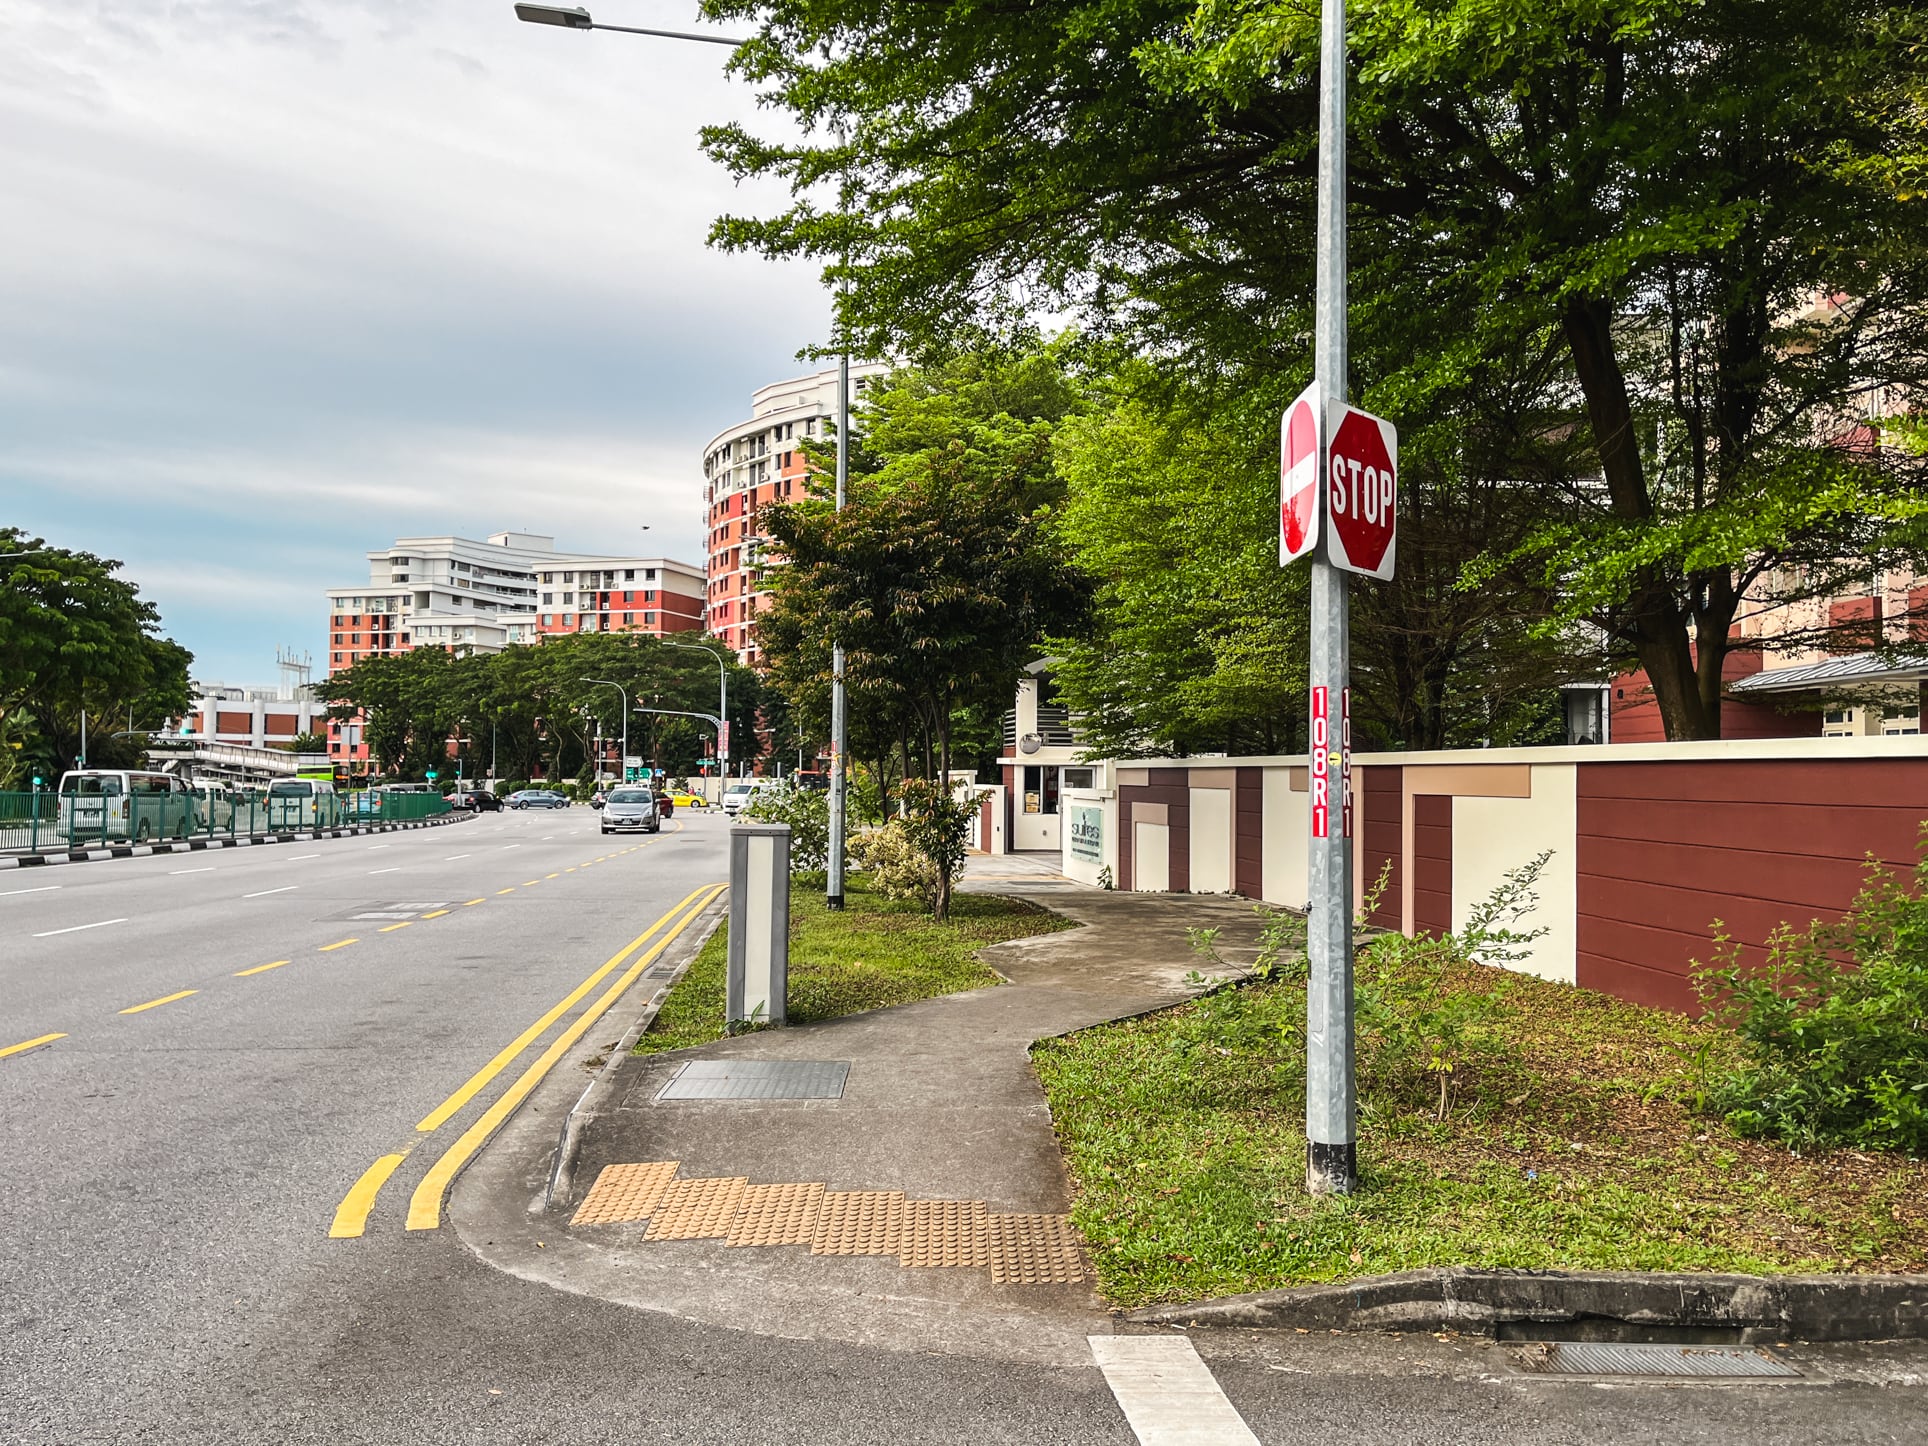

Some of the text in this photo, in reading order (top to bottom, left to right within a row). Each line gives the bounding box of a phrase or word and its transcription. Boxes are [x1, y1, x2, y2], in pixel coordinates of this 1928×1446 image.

[1332, 453, 1392, 528] STOP
[1313, 687, 1327, 837] 108R1
[1343, 688, 1351, 837] 108R1
